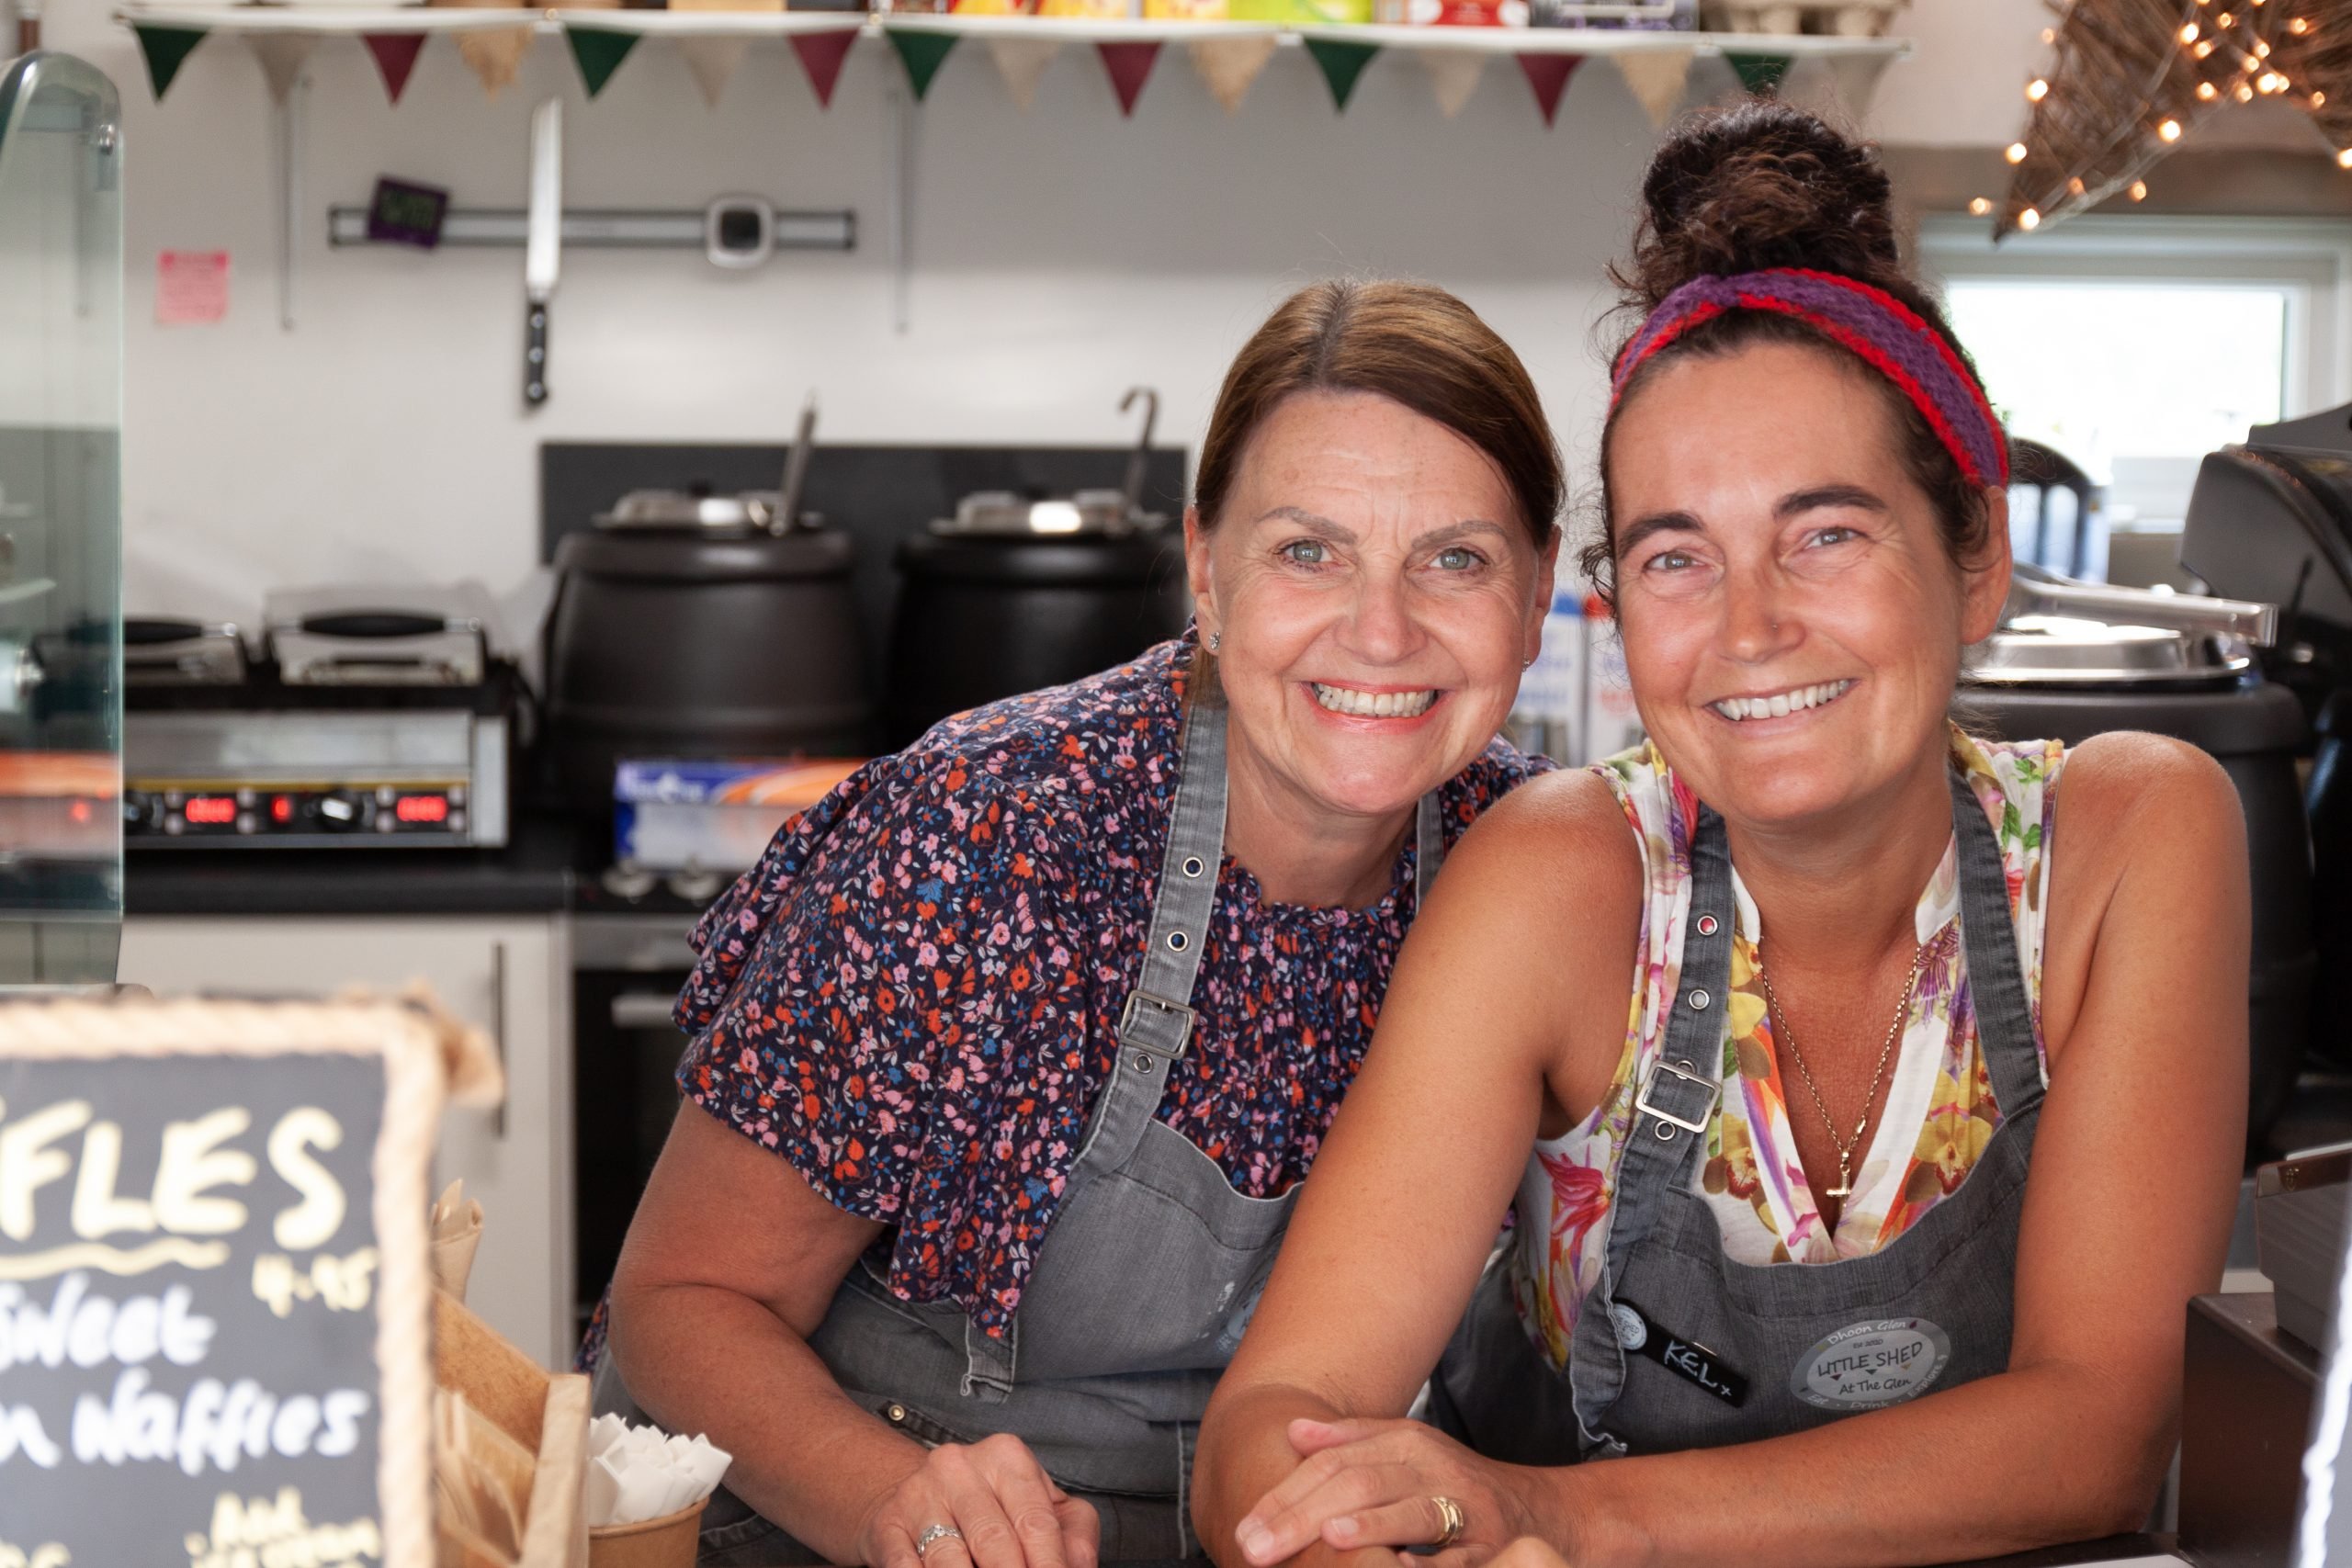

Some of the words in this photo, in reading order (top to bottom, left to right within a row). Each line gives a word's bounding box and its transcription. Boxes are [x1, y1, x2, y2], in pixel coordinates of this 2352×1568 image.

[0, 1100, 347, 1251] FLES
[1827, 1325, 1872, 1345] Dhoon
[1877, 1320, 1906, 1331] Glen
[1817, 1354, 1870, 1377] LITTLE
[1876, 1341, 1923, 1367] SHED
[1839, 1383, 1856, 1395] At
[1857, 1380, 1882, 1392] The
[1883, 1379, 1912, 1390] Glen
